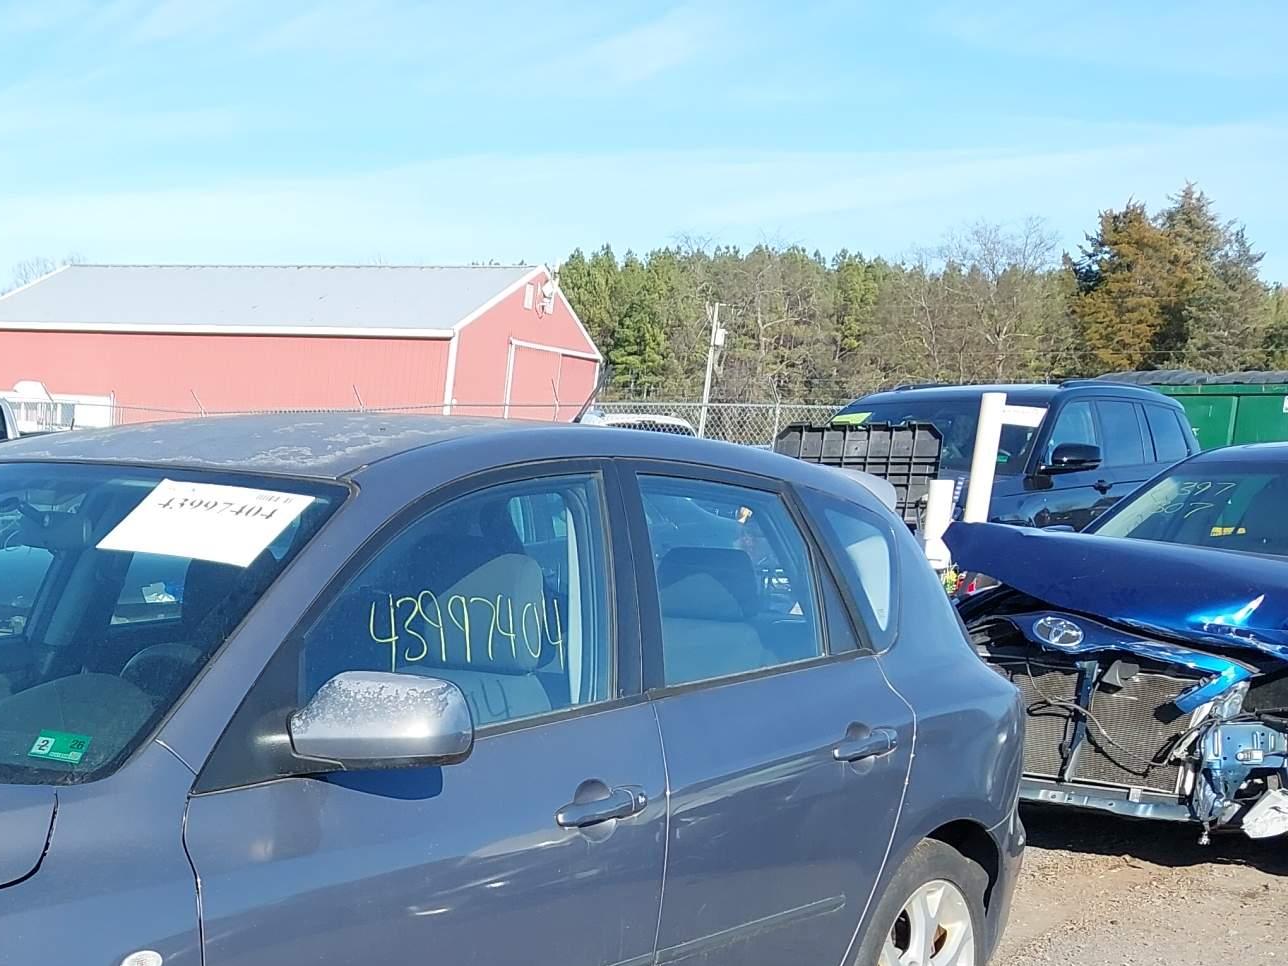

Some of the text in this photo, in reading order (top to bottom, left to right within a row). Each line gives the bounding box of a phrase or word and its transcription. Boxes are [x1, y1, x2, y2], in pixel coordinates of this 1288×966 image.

[157, 496, 279, 520] 43997404
[368, 589, 565, 673] 43997404
[37, 739, 50, 752] 2
